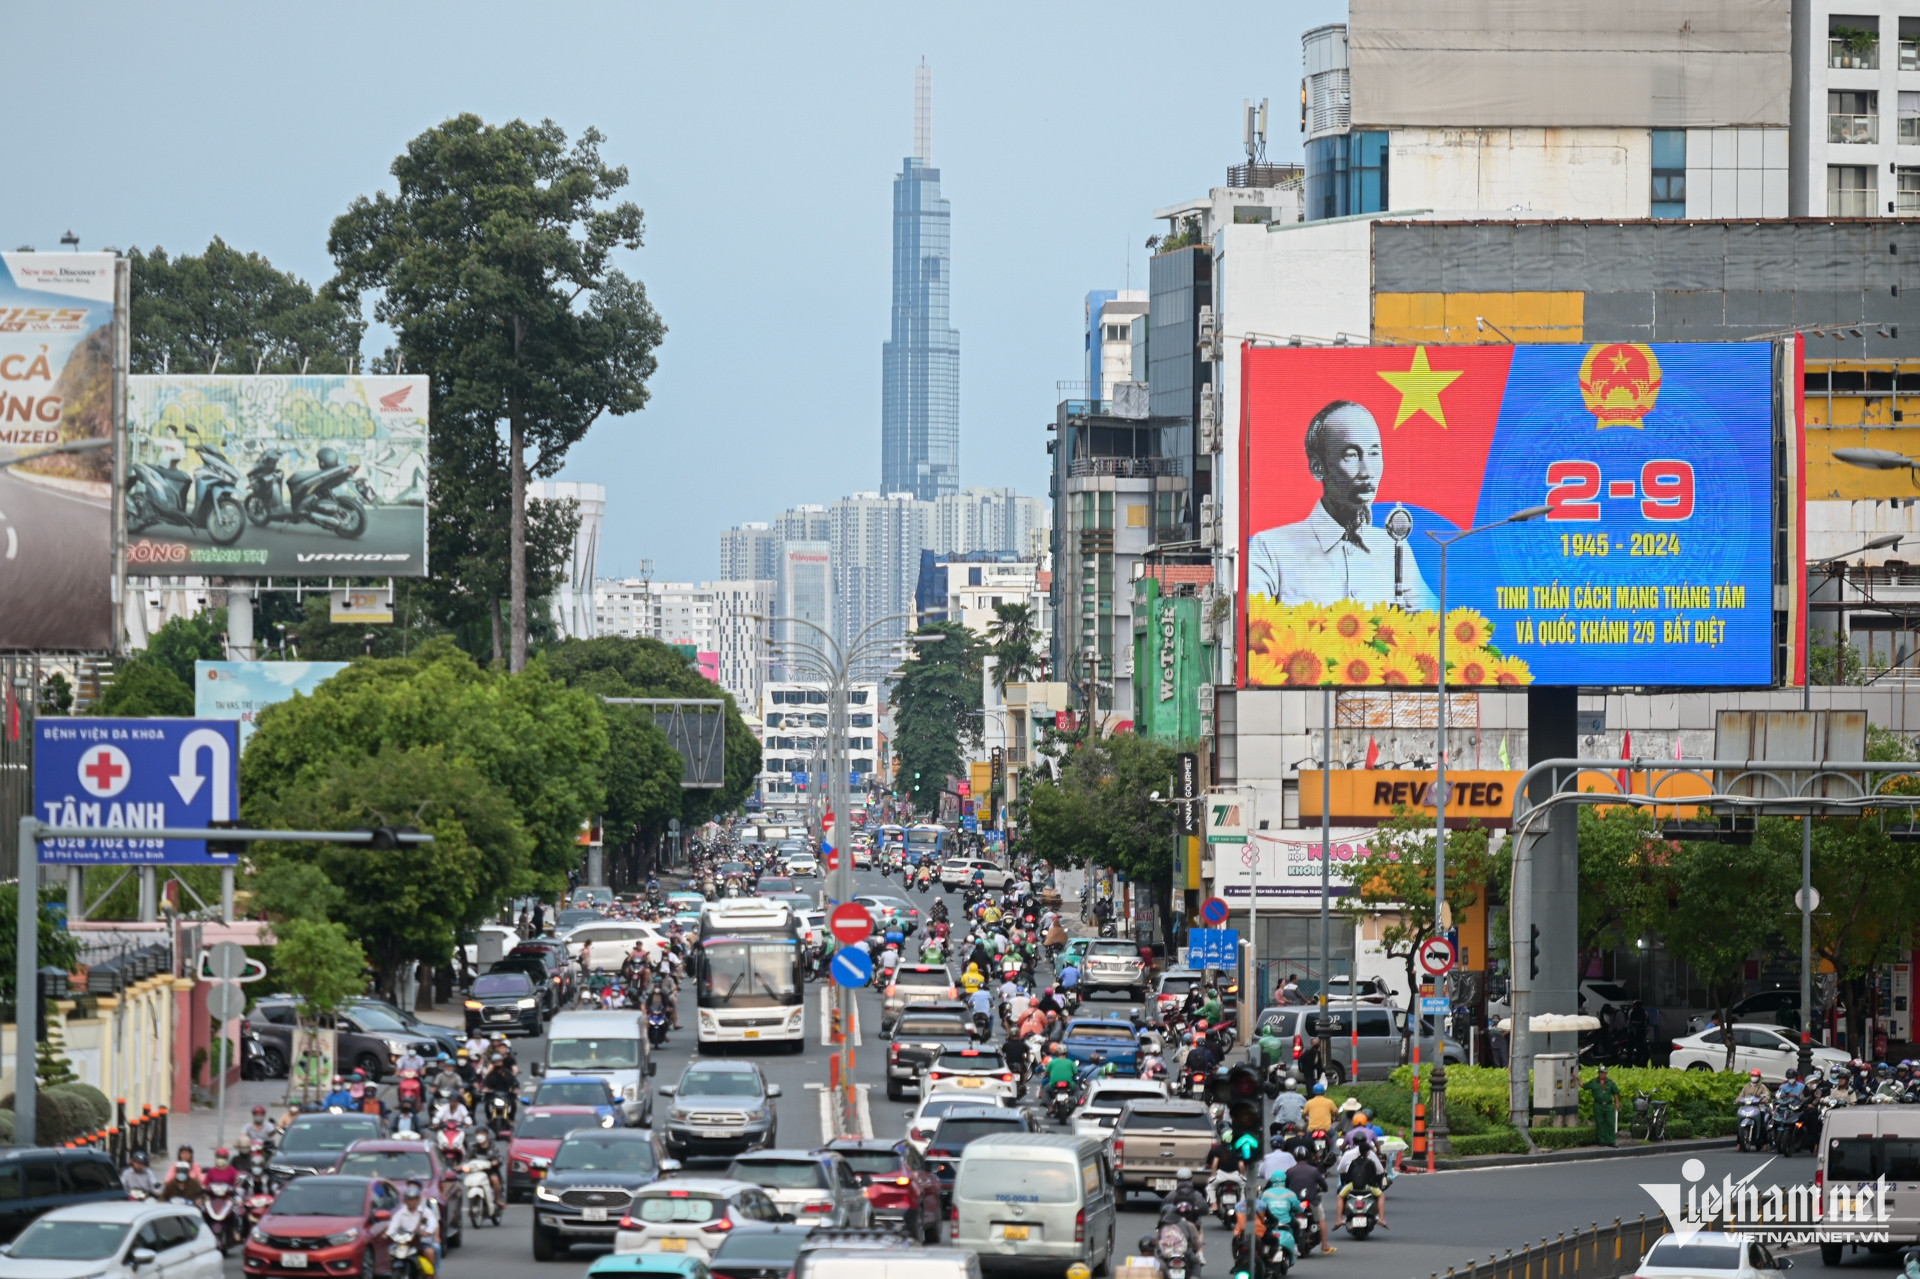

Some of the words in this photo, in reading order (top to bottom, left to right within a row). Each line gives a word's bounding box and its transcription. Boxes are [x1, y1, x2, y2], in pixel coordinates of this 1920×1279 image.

[0, 343, 52, 381] CẢ
[1545, 460, 1695, 521] 2-9
[1560, 533, 1609, 556] 1945
[1629, 533, 1681, 556] 2024
[1496, 586, 1529, 609] TINH
[1533, 579, 1570, 609] THẦN
[1574, 582, 1612, 609] CÁCH
[1616, 586, 1659, 614] MẠNG
[1663, 581, 1710, 609] THÁNG
[1714, 581, 1746, 609] TÁM
[1515, 616, 1534, 644] VÀ
[1538, 613, 1576, 646] QUỐC
[1580, 615, 1629, 644] KHÁNH
[1633, 620, 1655, 644] 2/9
[1663, 612, 1690, 644] BẤT
[1694, 616, 1726, 648] DIỆT
[1160, 606, 1176, 703] WeTrek
[43, 727, 77, 741] BỆNH
[80, 726, 109, 741] VIỆN
[112, 729, 129, 739] ĐA
[132, 729, 165, 739] KHOA
[1184, 757, 1192, 798] GOURMET
[44, 796, 100, 828] TÂM
[107, 802, 164, 828] ANH
[57, 838, 86, 849] 028
[91, 838, 123, 849] 7102
[1288, 851, 1306, 863] HỘP
